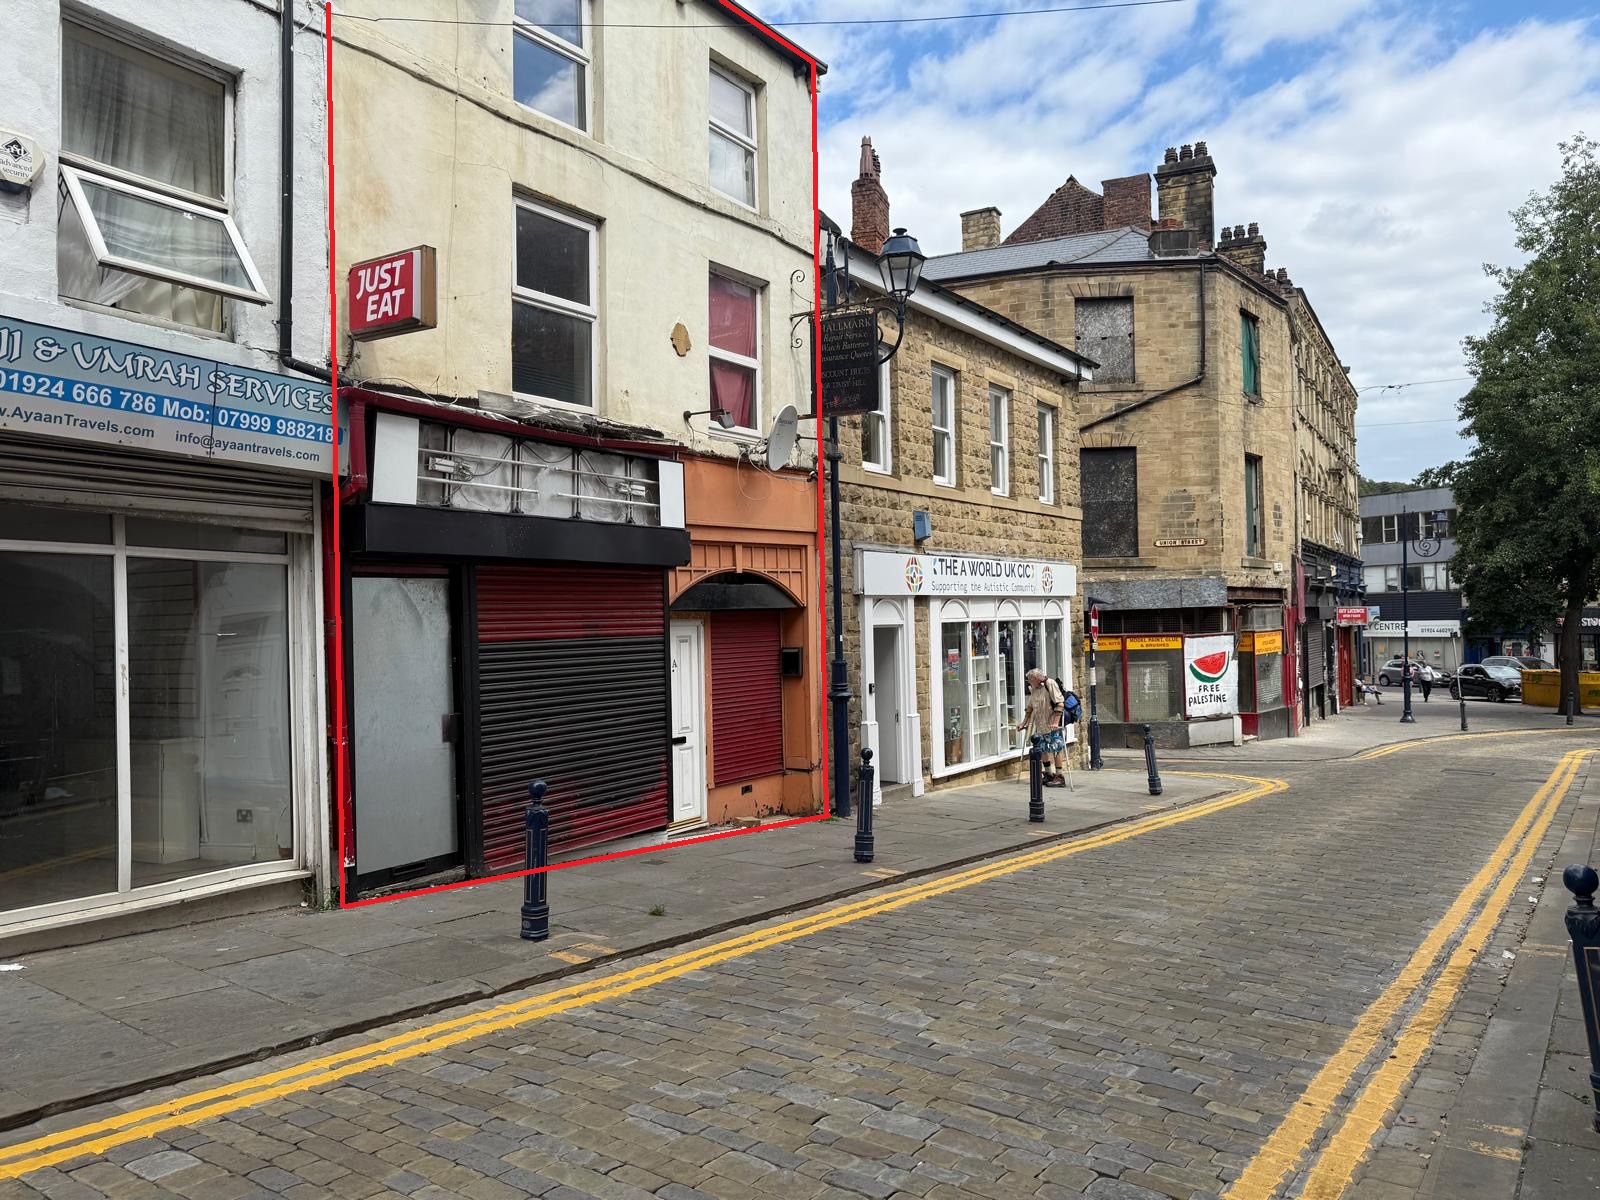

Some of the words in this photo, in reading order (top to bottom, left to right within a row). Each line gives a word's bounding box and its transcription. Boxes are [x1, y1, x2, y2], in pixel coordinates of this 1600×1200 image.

[3, 167, 30, 178] security
[356, 259, 405, 300] JUST
[366, 288, 405, 322] EAT
[33, 337, 67, 363] &
[71, 342, 201, 390] UMRAH
[207, 370, 333, 415] SERVICES
[72, 384, 113, 406] 666
[119, 391, 157, 414] 786
[162, 399, 211, 423] Mob:
[218, 410, 271, 432] 07999
[276, 420, 334, 442] 988218
[175, 430, 320, 461] info@ayaantravels.com
[938, 558, 959, 576] THE
[960, 560, 967, 576] A
[968, 560, 1003, 577] WORLD
[1004, 562, 1017, 578] UK
[1018, 564, 1031, 579] CIC
[931, 581, 968, 594] Supporting
[970, 581, 981, 591] the
[983, 582, 1009, 592] Autistic
[1011, 582, 1036, 594] Community
[1374, 621, 1405, 631] CENTRE
[1198, 684, 1221, 693] FREE
[1188, 693, 1227, 707] PALESTINE
